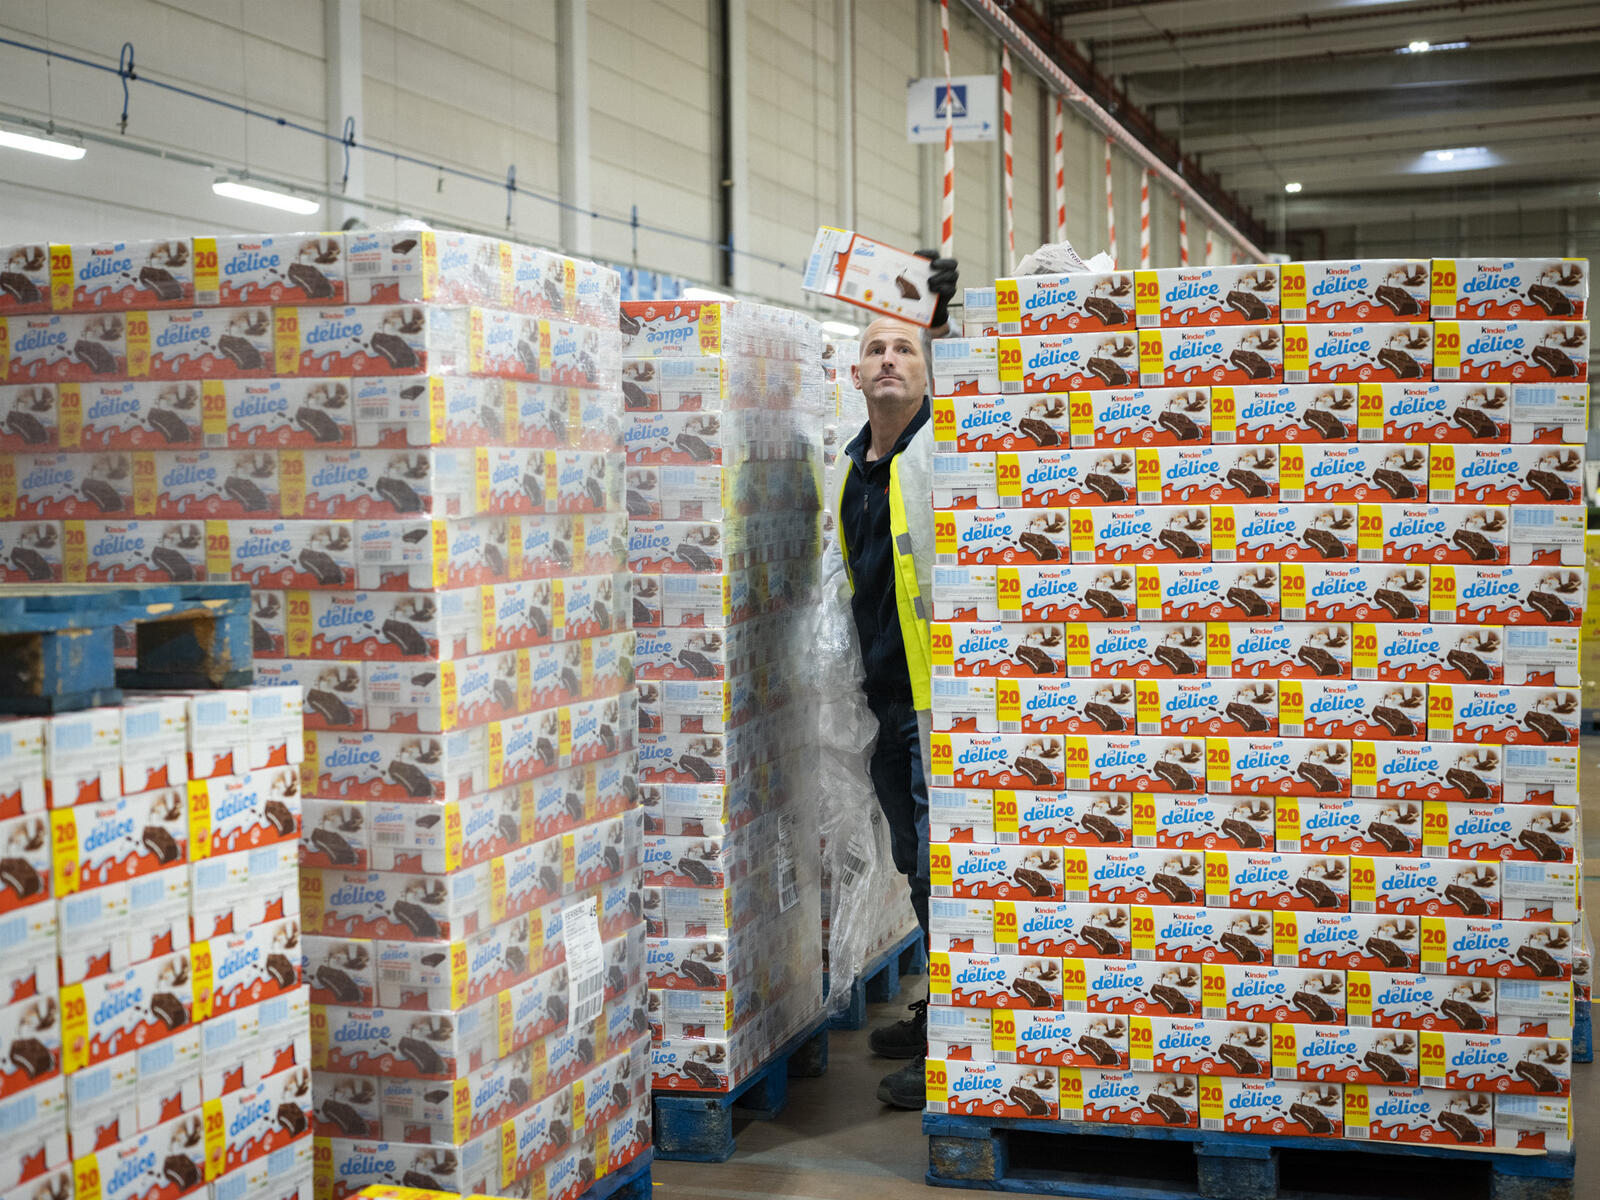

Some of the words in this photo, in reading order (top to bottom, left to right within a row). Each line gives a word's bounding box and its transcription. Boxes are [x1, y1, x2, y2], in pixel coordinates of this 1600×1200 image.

[195, 251, 217, 268] 20
[1284, 276, 1306, 290] 20
[1313, 276, 1368, 296] délice
[1434, 272, 1456, 286] 20
[1463, 274, 1520, 293] délice
[998, 291, 1018, 304] 20
[1138, 283, 1159, 296] 20
[1166, 282, 1219, 302] délice
[1026, 289, 1076, 309] délice
[128, 320, 148, 336] 20
[277, 317, 297, 333] 20
[1141, 342, 1161, 355] 20
[1437, 334, 1459, 348] 20
[1467, 335, 1524, 354] délice
[1170, 341, 1223, 360] délice
[204, 396, 225, 411] 20
[1213, 399, 1235, 412] 20
[1242, 400, 1296, 418] délice
[935, 410, 954, 423] 20
[962, 410, 1011, 429] délice
[1139, 460, 1160, 473] 20
[1167, 460, 1219, 479] délice
[1432, 457, 1454, 470] 20
[1462, 458, 1518, 477] délice
[936, 523, 955, 536] 20
[963, 523, 1012, 541] délice
[1214, 518, 1235, 531] 20
[1242, 518, 1295, 537] délice
[208, 536, 229, 551] 20
[1139, 577, 1159, 590] 20
[1167, 577, 1219, 596] délice
[1433, 578, 1455, 591] 20
[1463, 579, 1520, 598] délice
[290, 600, 309, 615] 20
[933, 635, 953, 648] 20
[959, 636, 1008, 654] délice
[1209, 634, 1229, 648] 20
[1237, 635, 1290, 654] délice
[1138, 692, 1158, 704] 20
[1166, 692, 1217, 711] délice
[1431, 697, 1453, 710] 20
[1460, 699, 1516, 718] délice
[933, 745, 951, 757] 20
[958, 746, 1008, 764] délice
[1208, 749, 1230, 762] 20
[1237, 751, 1288, 769] délice
[192, 793, 209, 812] 20
[1134, 805, 1154, 818] 20
[1162, 807, 1214, 825] délice
[1426, 814, 1448, 827] 20
[1455, 817, 1512, 835] délice
[56, 823, 75, 842] 20
[932, 855, 952, 868] 20
[958, 857, 1007, 874] délice
[1207, 864, 1227, 877] 20
[1235, 866, 1288, 884] délice
[1133, 918, 1154, 931] 20
[1161, 920, 1213, 938] délice
[1424, 930, 1446, 944] 20
[1453, 932, 1509, 951] délice
[194, 952, 211, 972] 20
[931, 963, 949, 976] 20
[957, 966, 1006, 983] délice
[1204, 976, 1225, 989] 20
[1232, 979, 1285, 997] délice
[65, 998, 85, 1018] 20
[1132, 1028, 1153, 1041] 20
[1159, 1031, 1211, 1049] délice
[1422, 1044, 1445, 1058] 20
[1452, 1047, 1507, 1066] délice
[928, 1071, 948, 1084] 20
[953, 1074, 1002, 1091] délice
[1062, 1078, 1083, 1091] 20
[1089, 1081, 1140, 1098] délice
[1201, 1087, 1223, 1101] 20
[1230, 1090, 1281, 1108] délice
[1346, 1094, 1367, 1108] 20
[206, 1112, 223, 1132] 20
